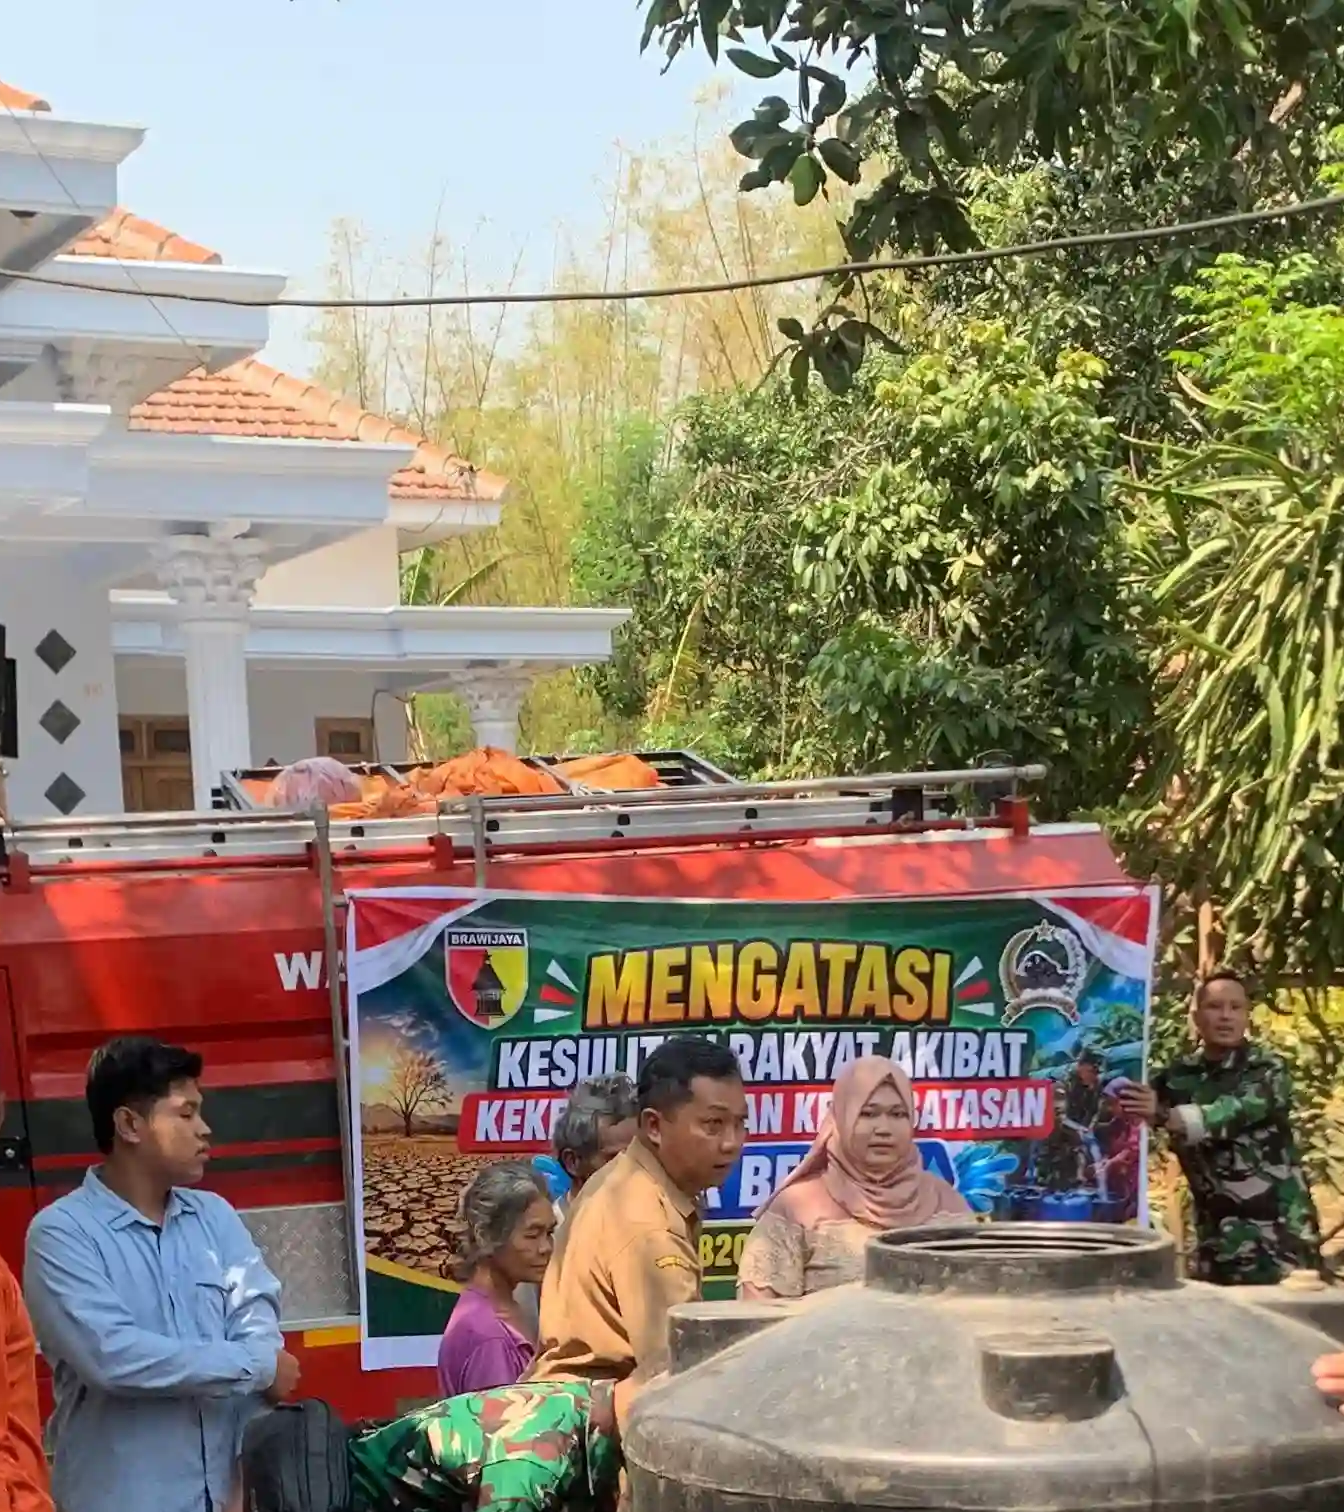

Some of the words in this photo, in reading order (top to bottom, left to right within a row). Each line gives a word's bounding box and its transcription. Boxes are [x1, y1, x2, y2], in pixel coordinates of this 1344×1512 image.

[451, 933, 523, 945] BRAWIJAYA
[586, 941, 951, 1028] MENGATASI
[729, 1031, 880, 1081] RAKYAT
[889, 1031, 1028, 1078] AKIBAT
